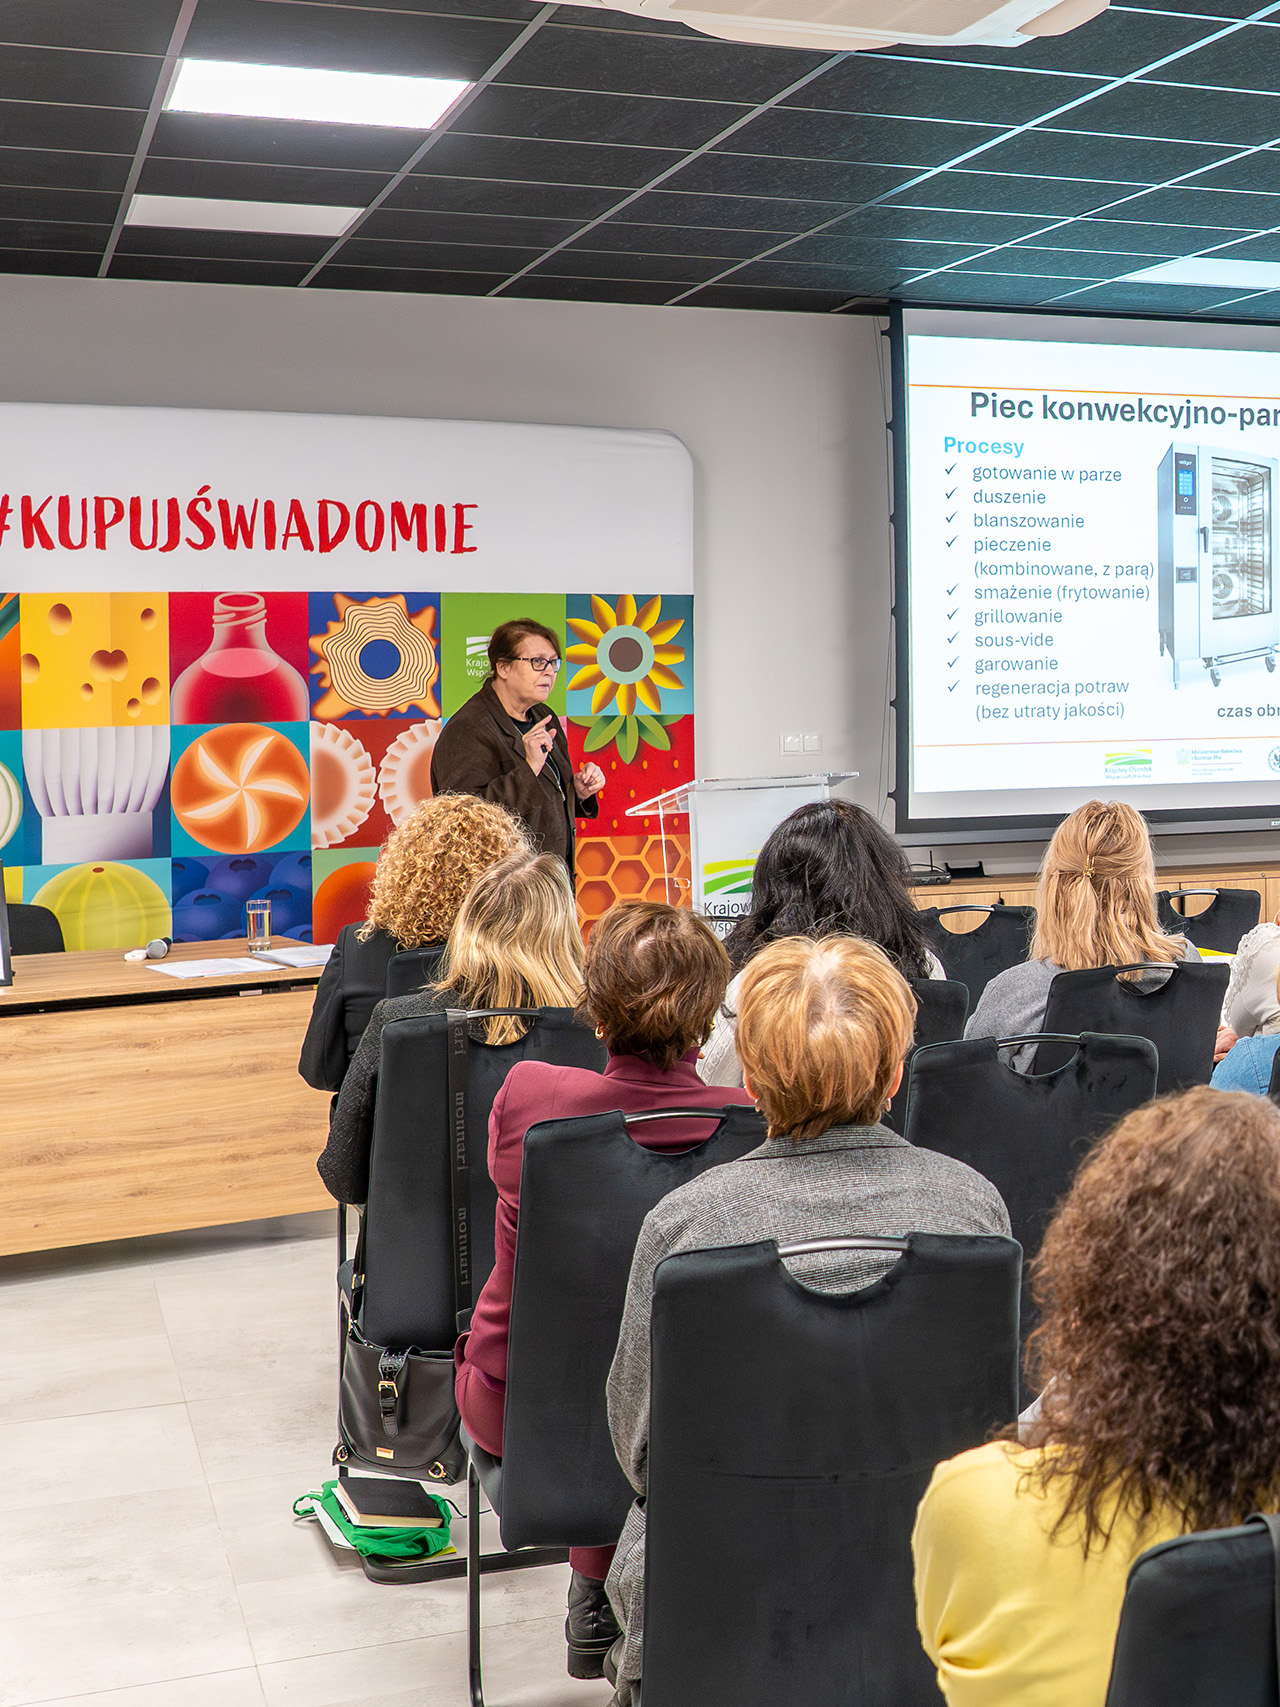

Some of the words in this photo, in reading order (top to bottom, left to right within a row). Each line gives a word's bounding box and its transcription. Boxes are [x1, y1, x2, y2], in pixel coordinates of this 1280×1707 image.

[971, 390, 1034, 419] Piec
[945, 437, 1024, 458] Procesy
[973, 466, 1056, 482] gotowanie
[1061, 470, 1074, 480] w
[1080, 470, 1121, 484] parze
[974, 489, 1046, 504] duszenie
[974, 513, 1084, 528] blanszowanie
[975, 537, 1051, 554] pieczenie
[975, 561, 1097, 578] (kombinowane,
[1103, 565, 1110, 576] z
[1116, 562, 1154, 579] parą)
[975, 585, 1052, 599] smażenie
[1057, 585, 1149, 602] (frytowanie)
[975, 609, 1062, 626] grillowanie
[976, 632, 1053, 647] sous-vide
[466, 658, 489, 669] Krajo
[975, 656, 1058, 674] garowanie
[976, 680, 1070, 698] regeneracja
[1076, 681, 1129, 696] potraw
[976, 705, 1009, 722] (bez
[1015, 705, 1060, 720] utraty
[1064, 702, 1124, 720] jakości)
[1218, 707, 1252, 717] czas
[704, 899, 752, 917] Krajow
[455, 1091, 467, 1172] monnari
[457, 1207, 470, 1285] monnari
